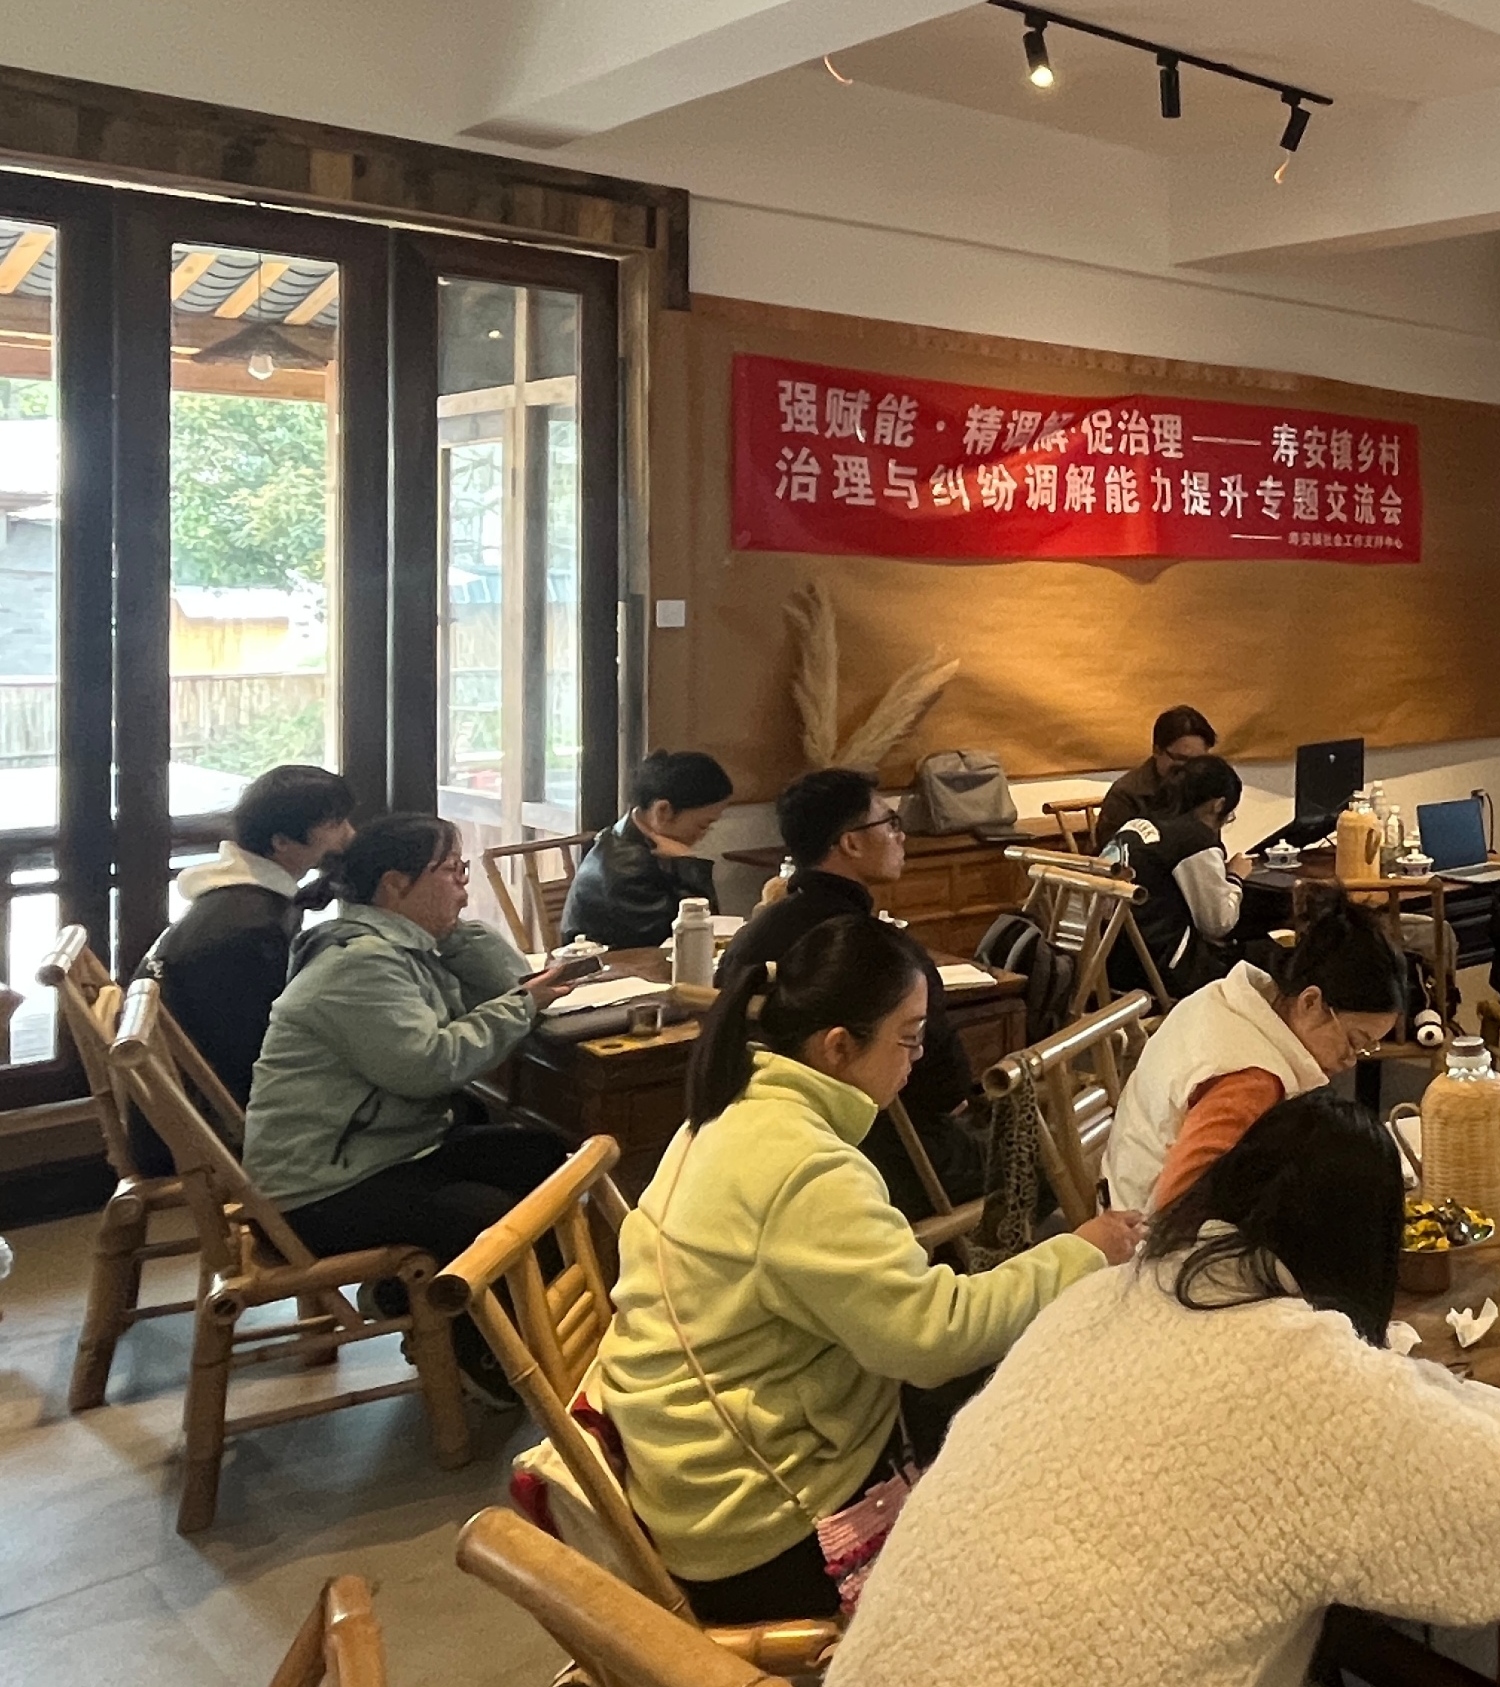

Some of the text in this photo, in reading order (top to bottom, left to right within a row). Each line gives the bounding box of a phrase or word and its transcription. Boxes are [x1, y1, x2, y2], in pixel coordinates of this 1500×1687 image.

[775, 446, 1402, 525] 治理与纠纷调解能力提升专题交流会
